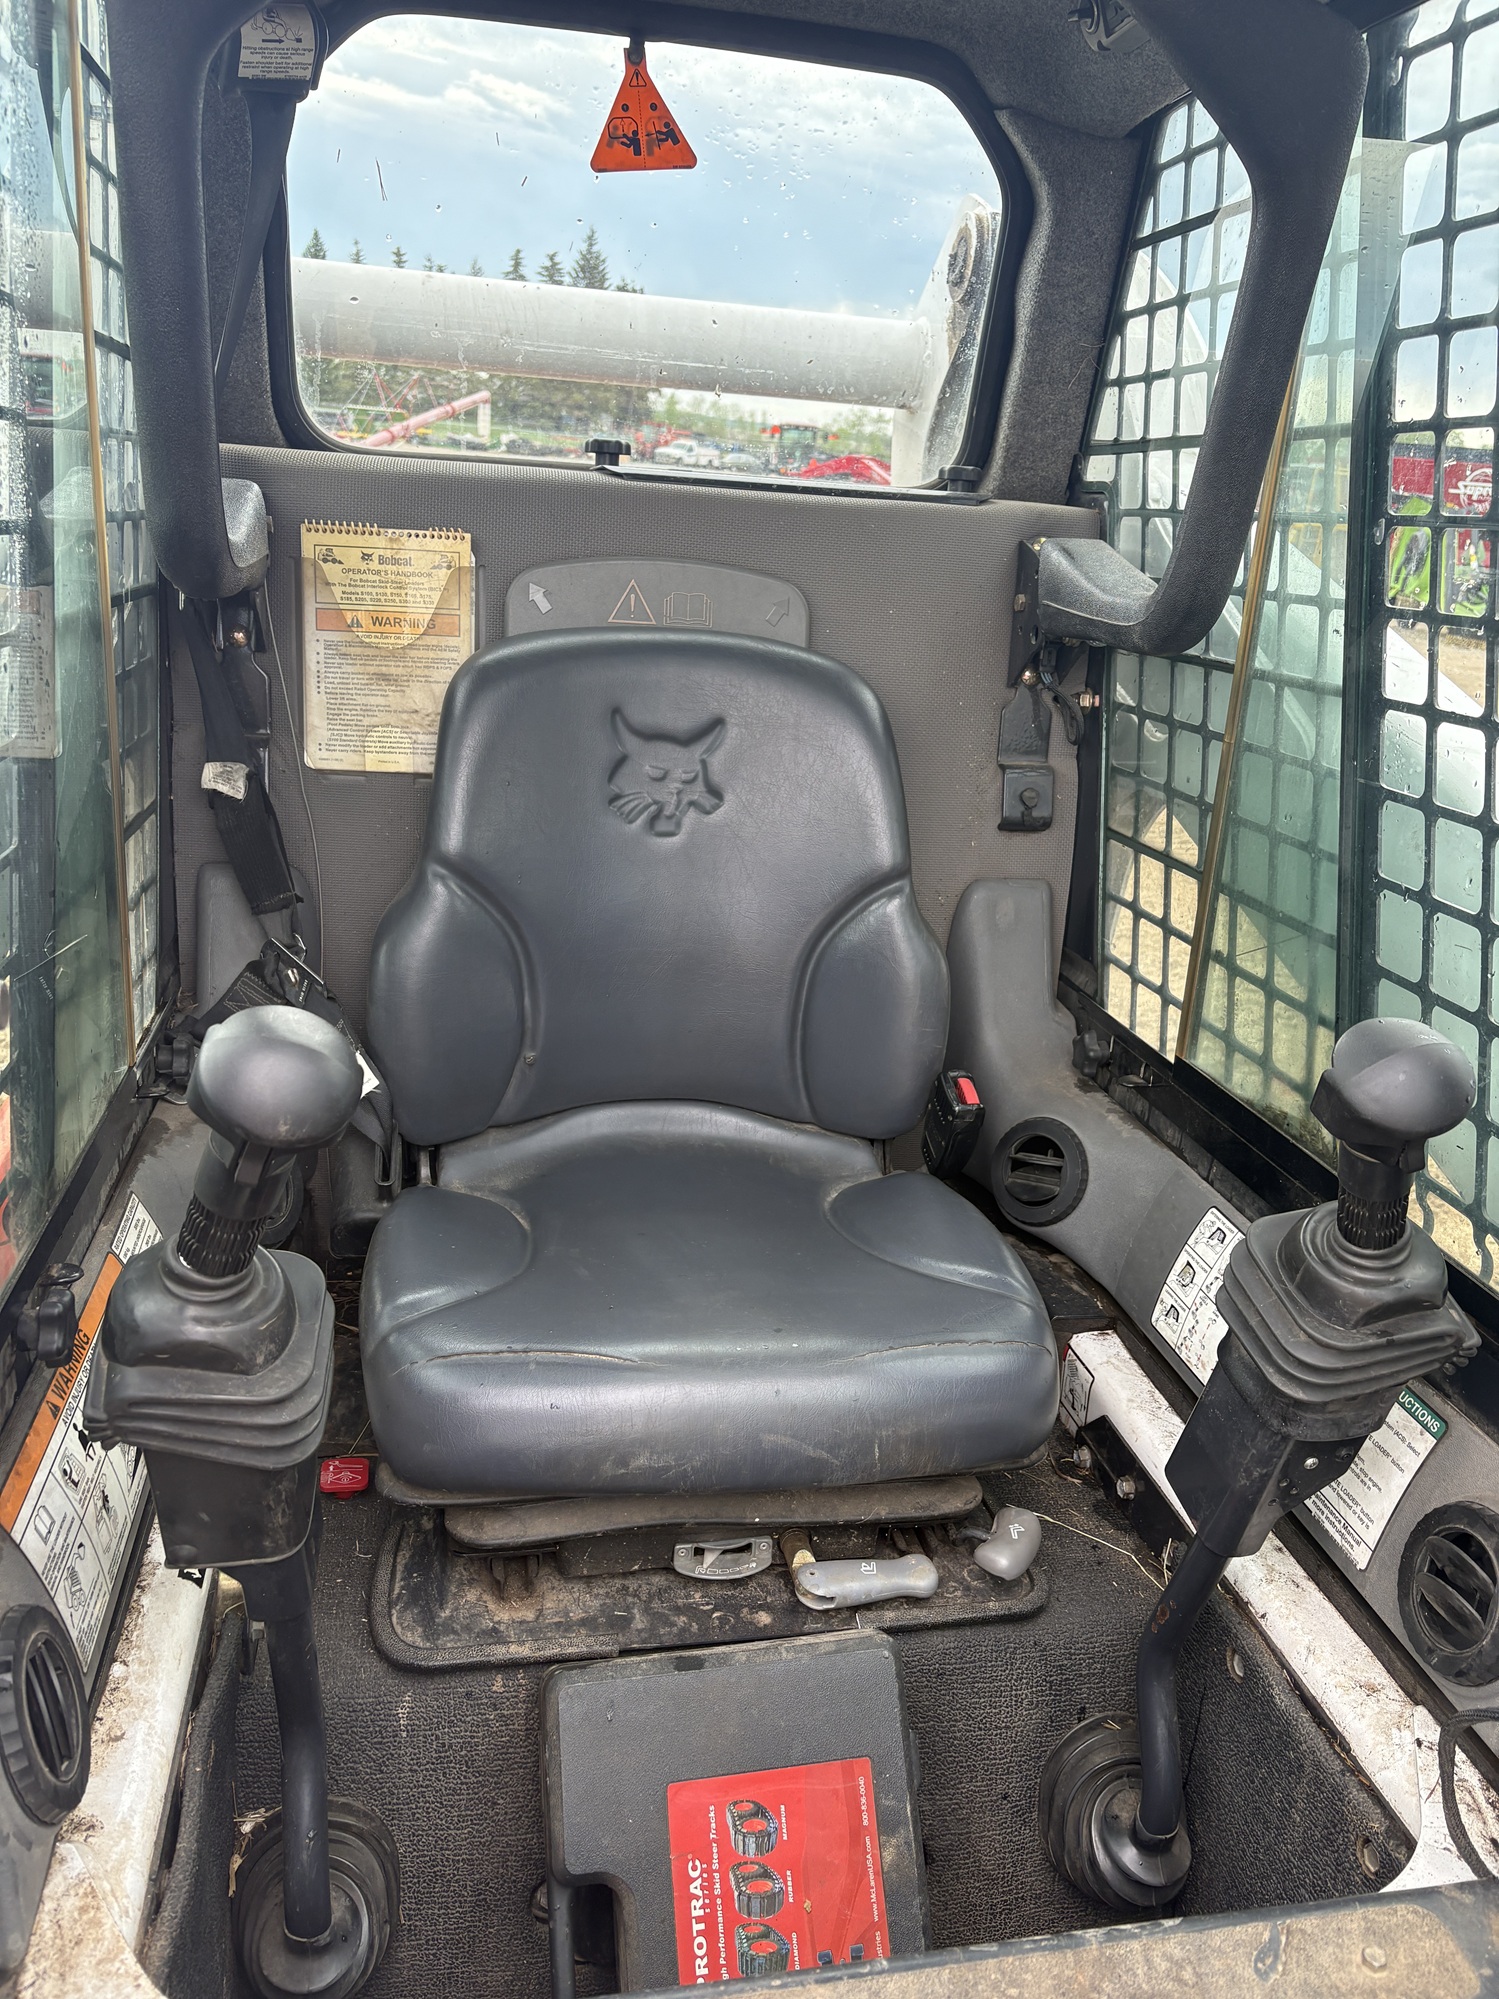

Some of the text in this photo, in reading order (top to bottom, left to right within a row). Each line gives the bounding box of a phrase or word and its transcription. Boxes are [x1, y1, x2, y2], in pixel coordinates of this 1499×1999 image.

[341, 568, 433, 578] OPERATOR'S HANDBOOK
[378, 554, 412, 566] Bobcat
[371, 616, 436, 629] WARNING
[51, 1329, 91, 1401] WARNING
[61, 1401, 75, 1427] AVOID
[71, 1377, 85, 1404] INJURY
[1398, 1391, 1441, 1434] UCTIONS
[1314, 1493, 1342, 1525] aintenance
[1342, 1522, 1362, 1547] Manual
[708, 1805, 717, 1840] Tracks
[858, 1776, 869, 1826] 800-836-0040
[711, 1841, 719, 1870] Steer
[712, 1873, 721, 1894] Skid
[864, 1835, 879, 1922] www.McLarenUSA.com
[716, 1897, 728, 1966] Performance
